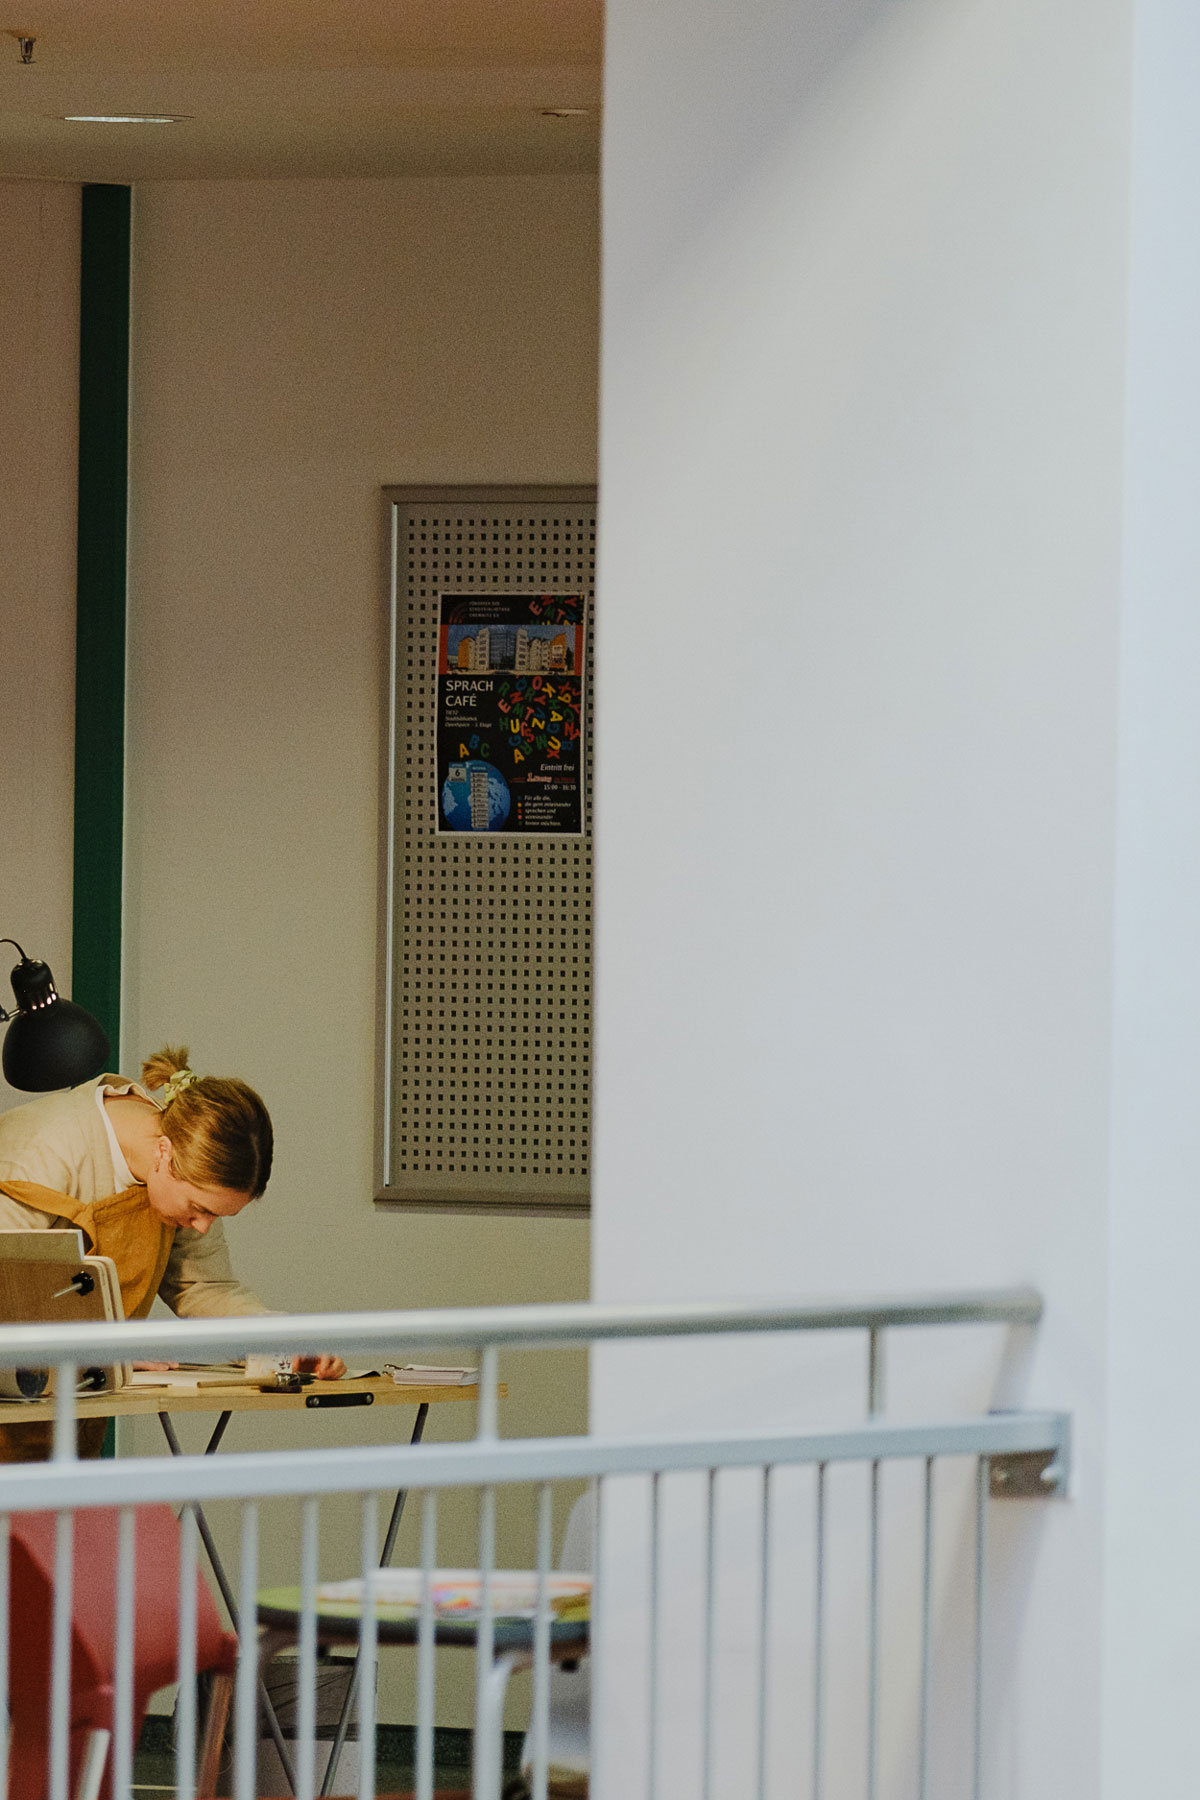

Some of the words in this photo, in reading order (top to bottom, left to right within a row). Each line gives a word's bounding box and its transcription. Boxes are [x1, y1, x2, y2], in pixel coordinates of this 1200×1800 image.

[445, 680, 494, 692] SPRACH
[445, 693, 477, 707] CAFÉ
[540, 763, 562, 771] Eintritt
[563, 763, 575, 771] frei
[455, 769, 460, 777] 6
